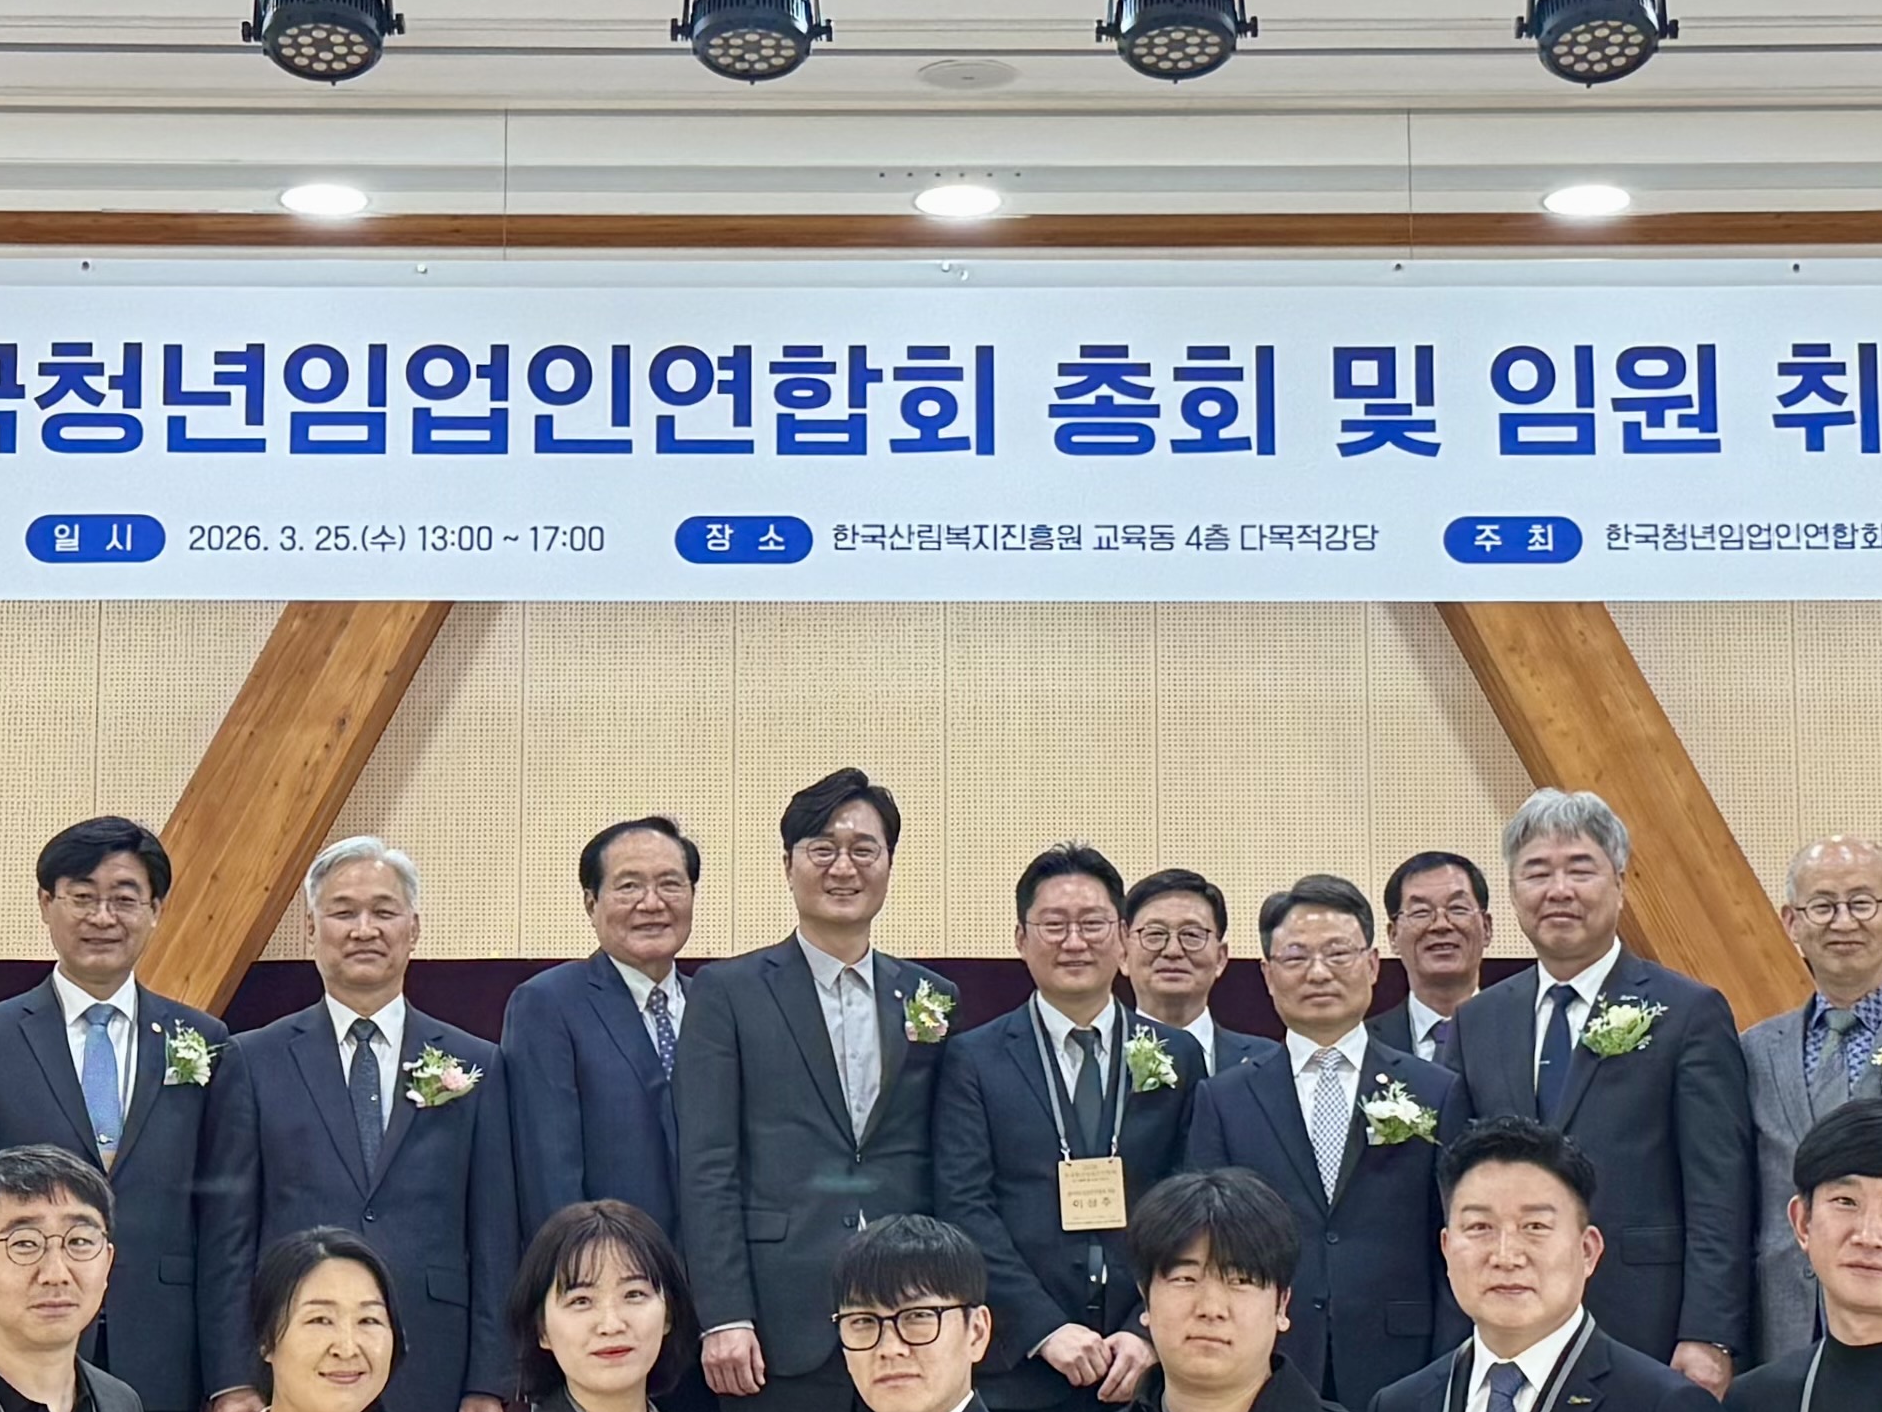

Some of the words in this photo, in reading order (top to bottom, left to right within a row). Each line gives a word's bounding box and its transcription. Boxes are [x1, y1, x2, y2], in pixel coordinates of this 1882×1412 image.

[1047, 344, 1276, 456] 총회
[1332, 344, 1442, 458] 및
[1490, 343, 1722, 456] 임원
[188, 524, 269, 551] 2026.
[279, 525, 304, 552] 3.
[315, 524, 406, 553] 25.(수)
[418, 525, 493, 552] 13:00
[530, 525, 605, 552] 17:00
[832, 523, 1082, 552] 한국산림복지진흥원
[1092, 523, 1176, 552] 교육동
[1184, 523, 1231, 552] 4층
[1240, 523, 1380, 552] 다목적강당
